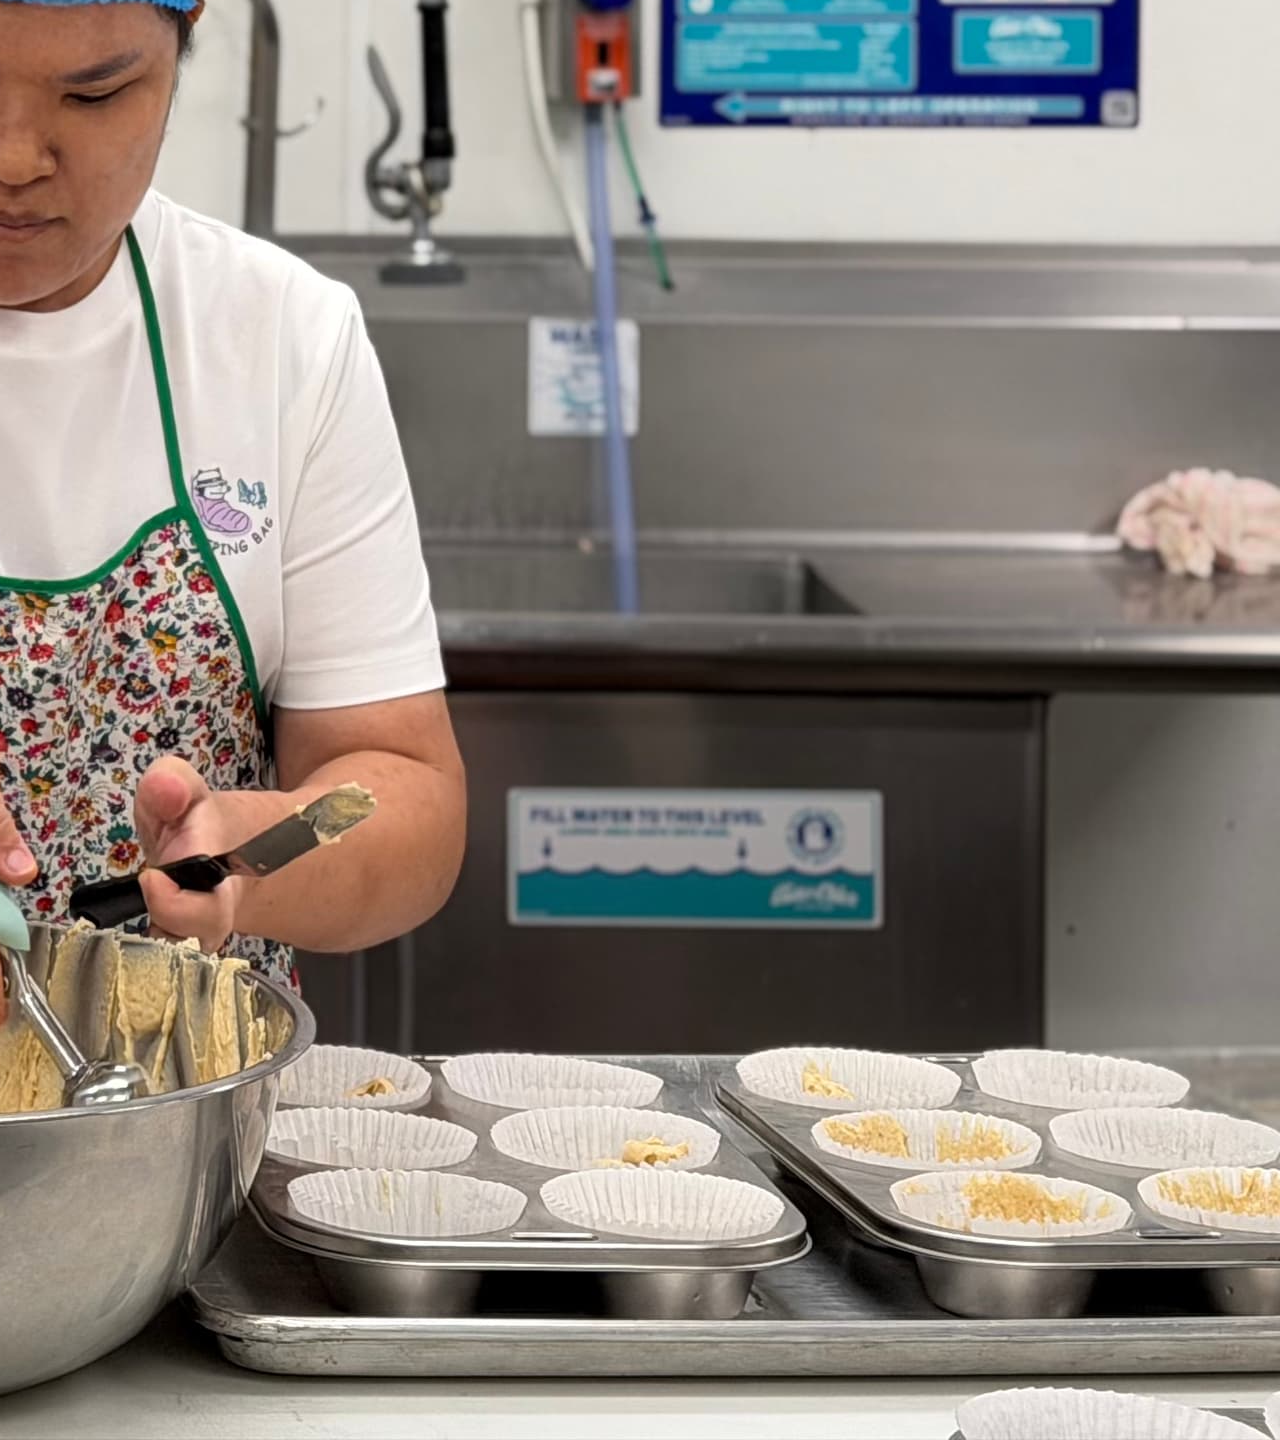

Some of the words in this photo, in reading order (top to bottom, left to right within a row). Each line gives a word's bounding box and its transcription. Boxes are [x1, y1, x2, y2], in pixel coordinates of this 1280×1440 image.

[250, 517, 274, 545] BAG
[529, 807, 567, 825] FILL
[572, 807, 633, 825] WATER
[639, 808, 660, 825] TO
[666, 808, 704, 825] THIS
[709, 809, 767, 827] LEVEL
